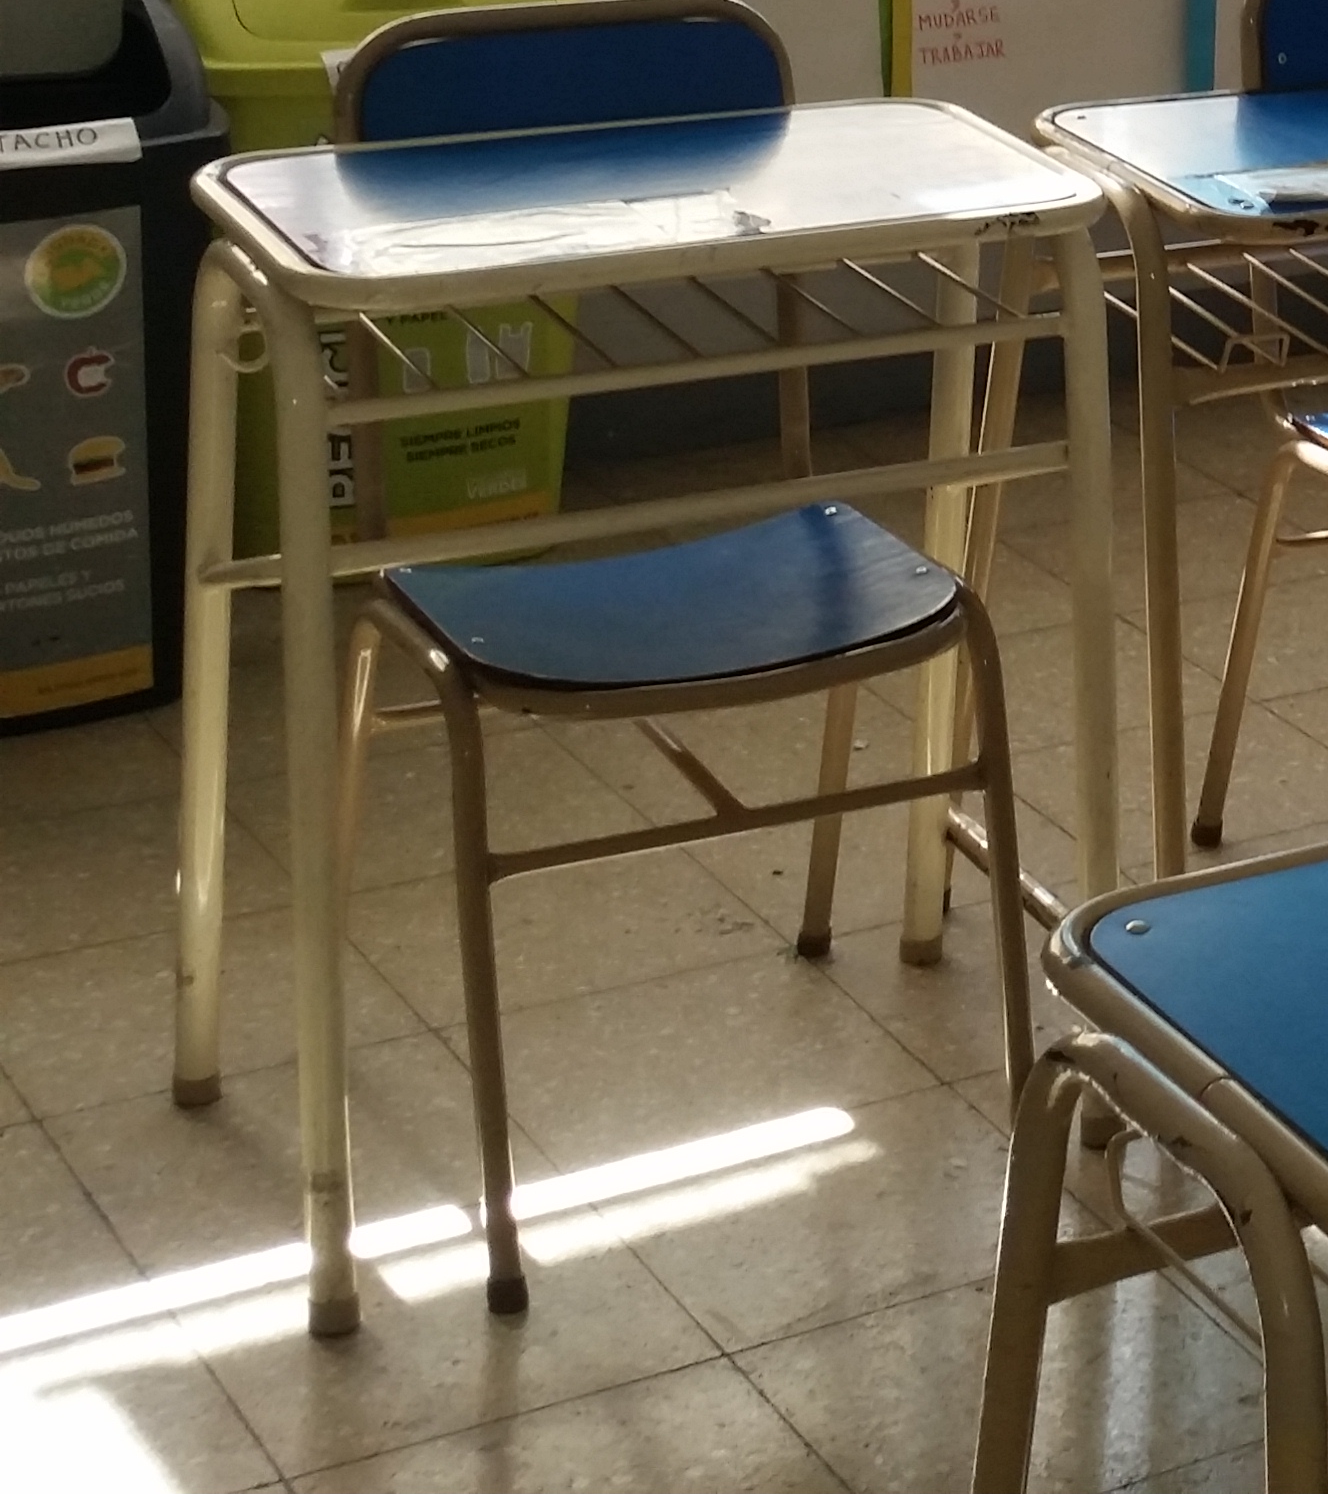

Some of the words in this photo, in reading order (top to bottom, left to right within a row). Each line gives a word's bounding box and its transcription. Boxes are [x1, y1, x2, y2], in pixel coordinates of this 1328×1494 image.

[916, 5, 1001, 32] MUDARSE
[918, 37, 1006, 67] TRABAJAR
[0, 126, 98, 153] TACHO
[470, 435, 517, 453] SECOS
[71, 527, 139, 551] COMIDA
